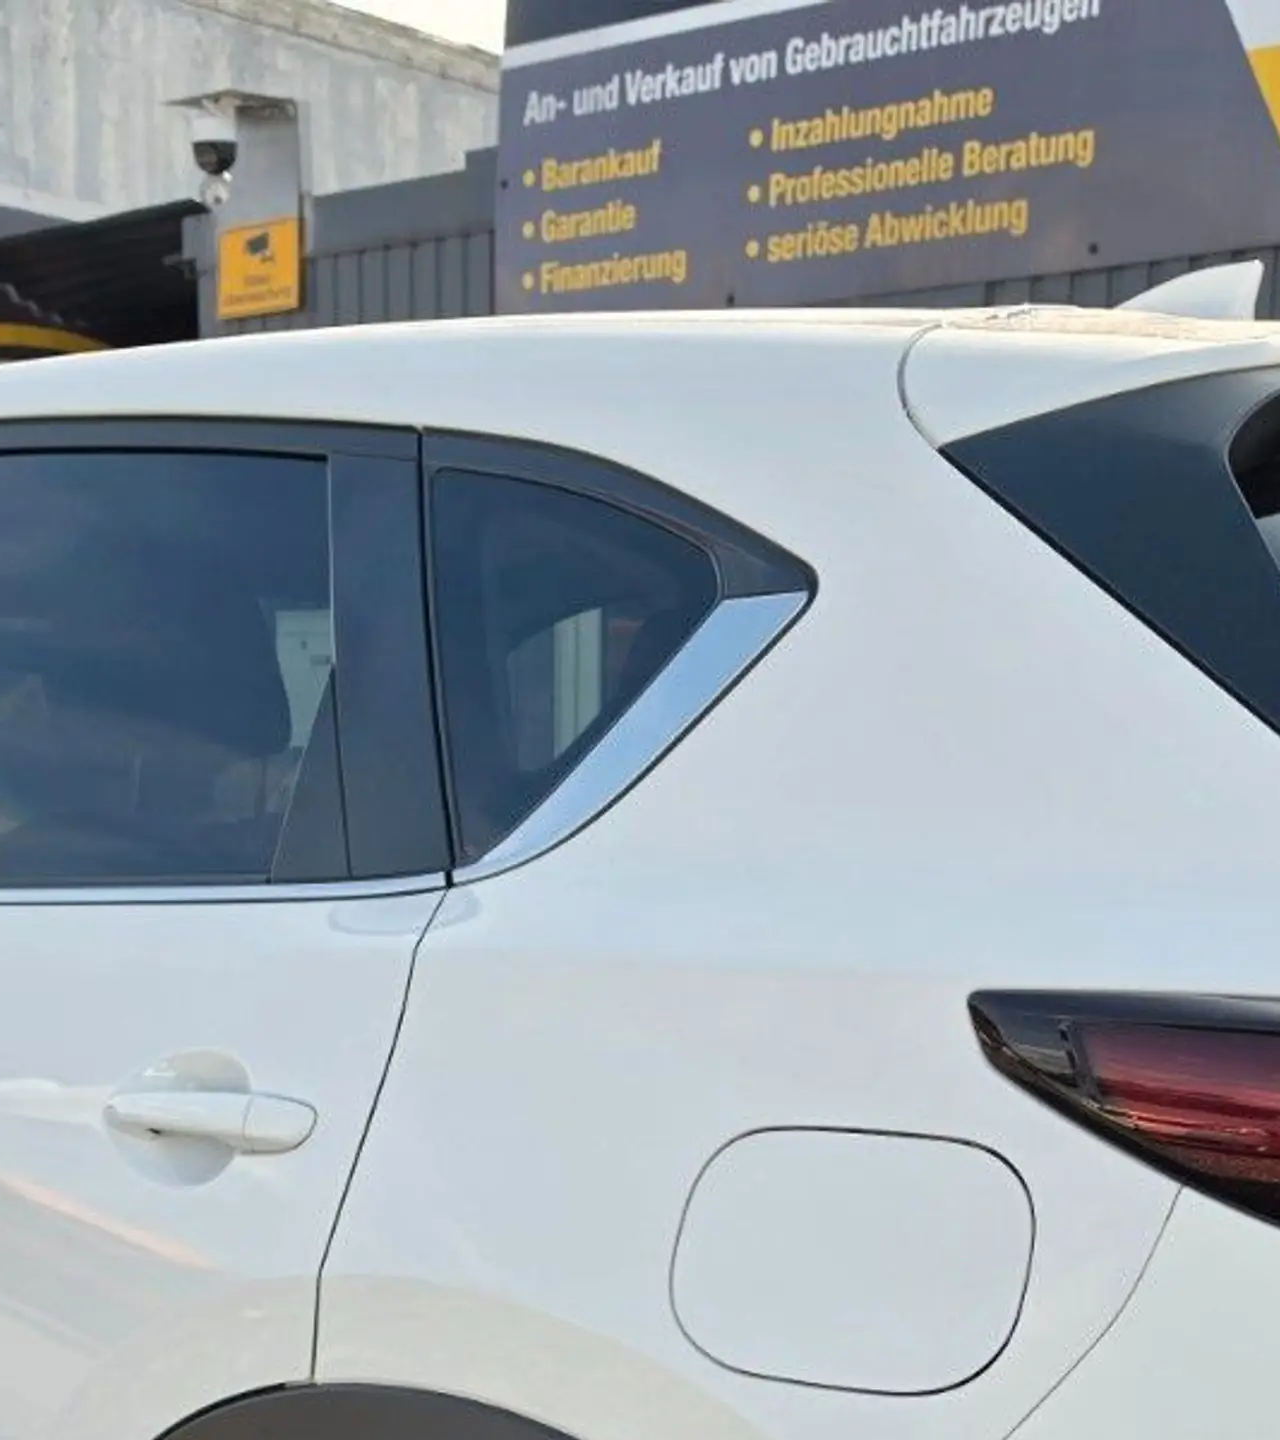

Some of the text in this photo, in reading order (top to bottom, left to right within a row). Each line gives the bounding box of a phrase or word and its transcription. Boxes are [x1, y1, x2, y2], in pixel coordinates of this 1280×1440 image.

[523, 0, 1100, 127] An- und Verkauf von Gebrauchtfahrzeugen
[771, 86, 995, 152] Inzahlungnahme
[541, 138, 662, 192] Barankauf
[769, 129, 1096, 208] Professionelle Beratung
[541, 198, 637, 243] Garantie
[767, 198, 1030, 263] seriöse Abwicklung
[540, 249, 687, 294] Finanzierung
